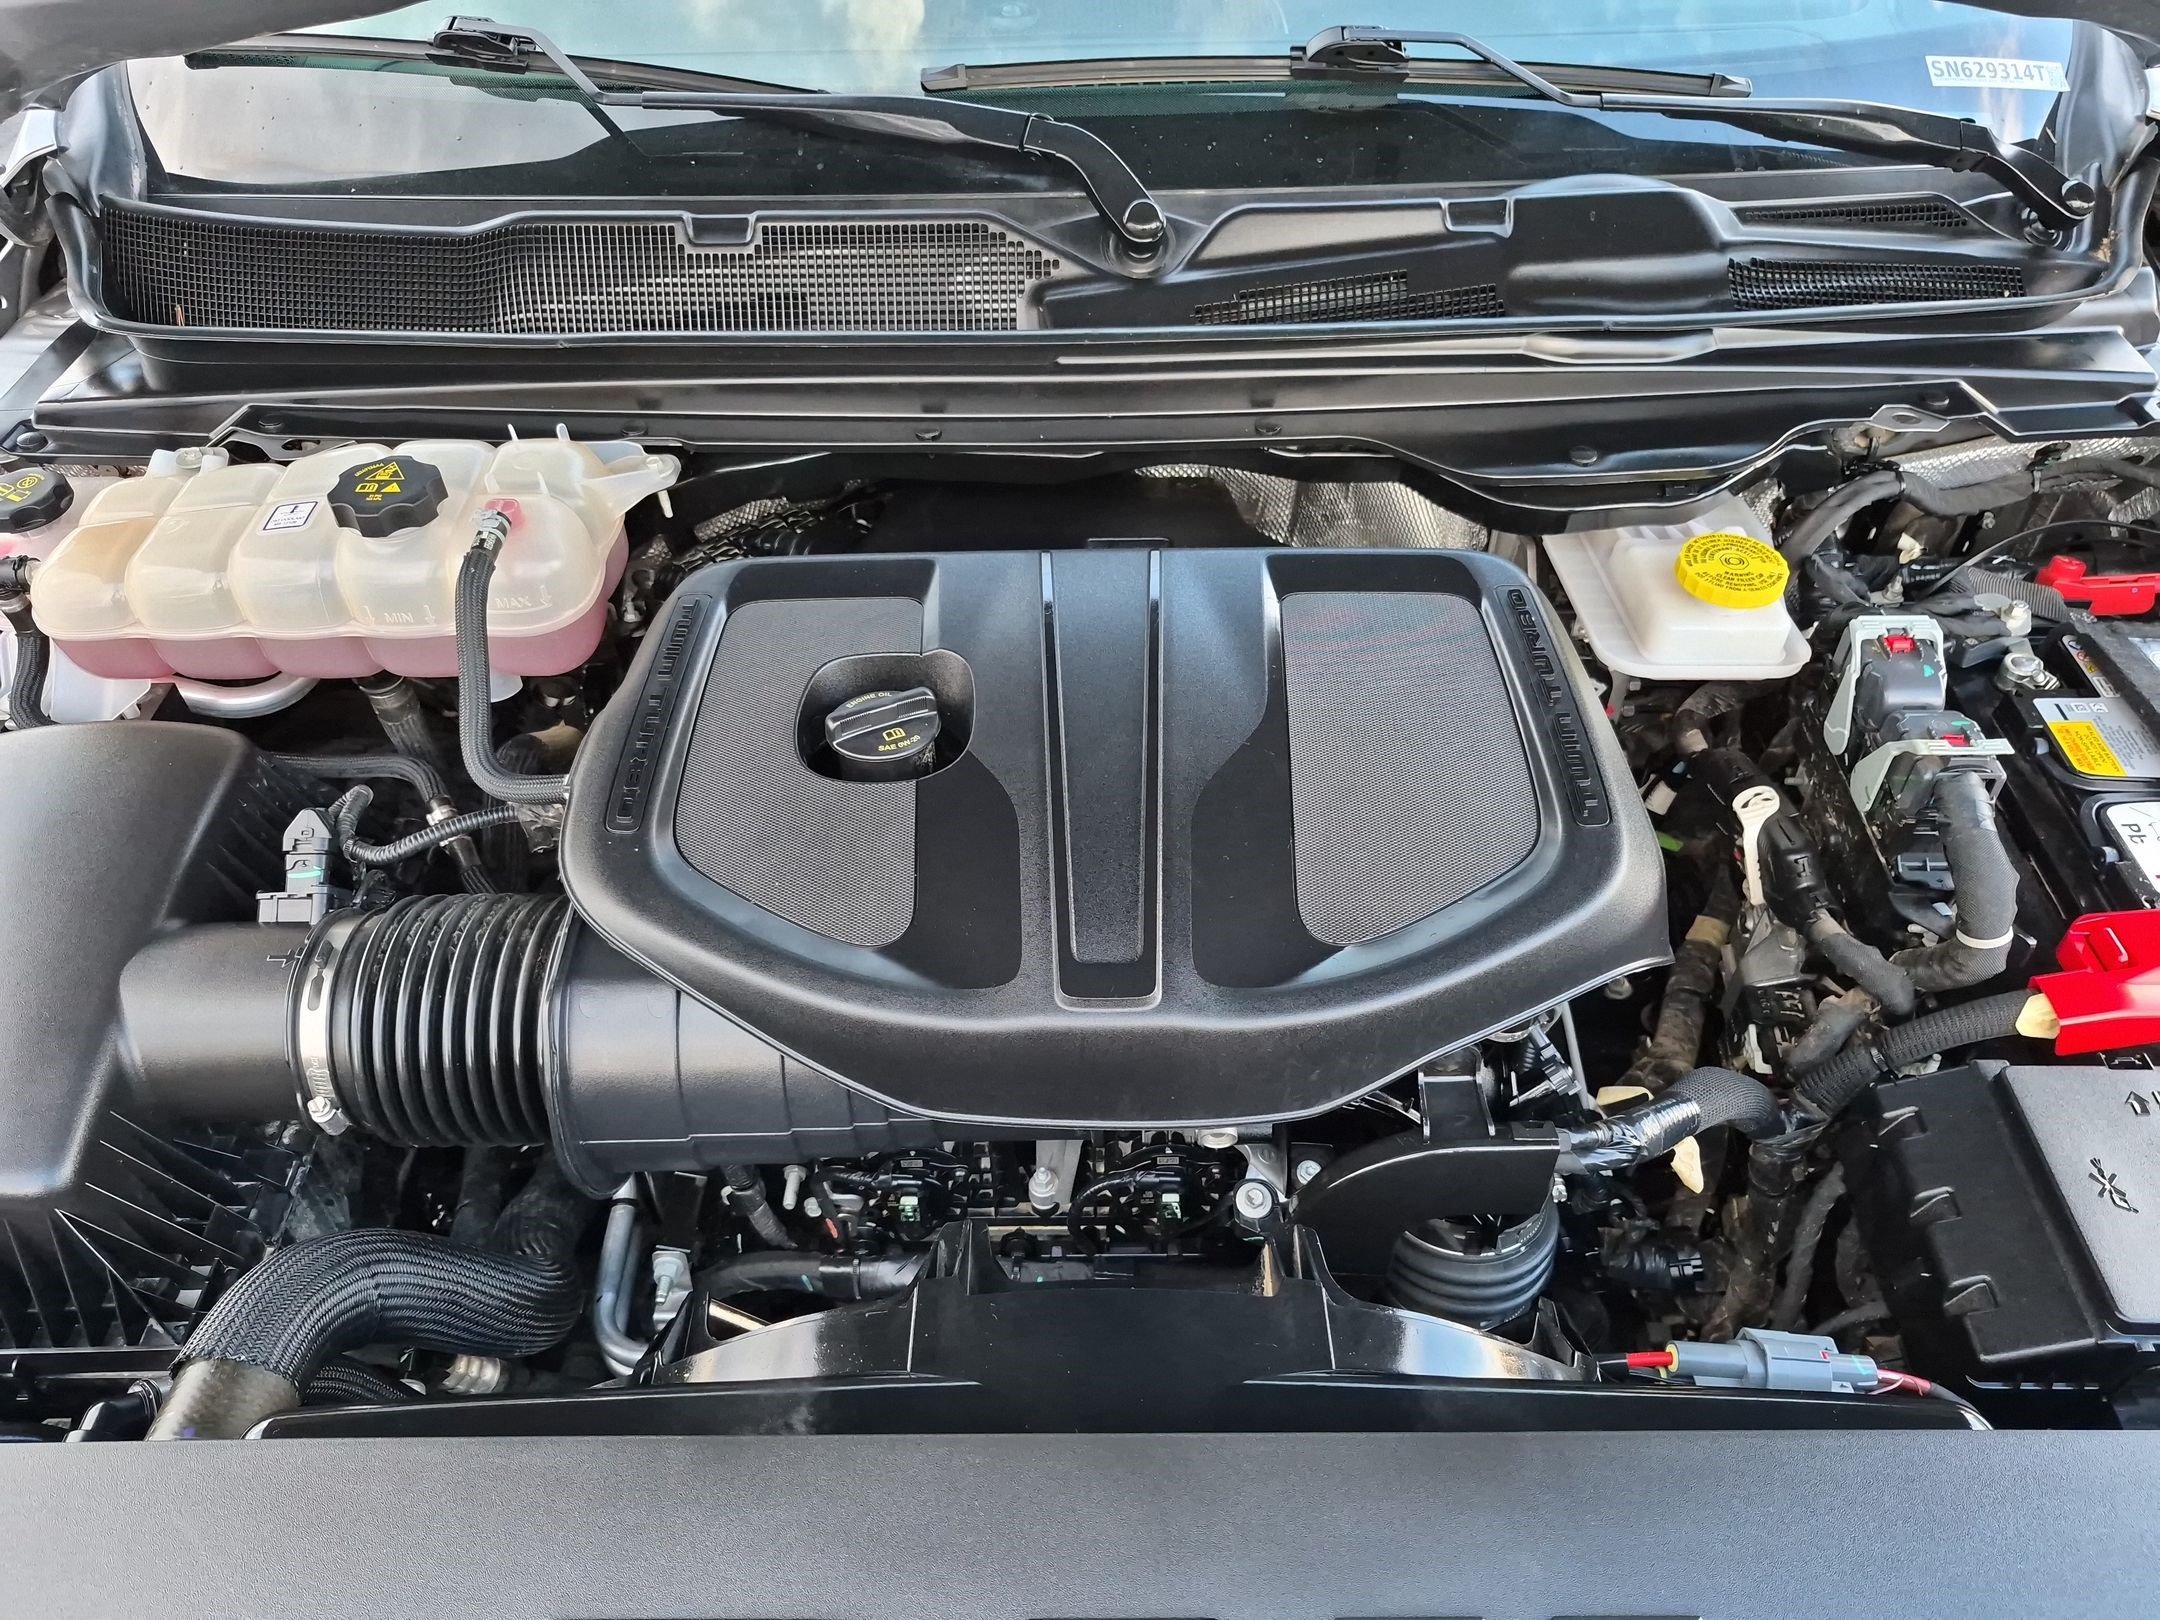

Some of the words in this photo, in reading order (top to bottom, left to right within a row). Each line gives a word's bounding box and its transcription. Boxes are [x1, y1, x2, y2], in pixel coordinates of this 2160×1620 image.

[1932, 60, 2044, 81] SN629314T
[385, 612, 413, 624] MIN
[658, 598, 700, 682] TWIN
[1507, 588, 1562, 707] TURBO
[846, 693, 876, 709] ENGINE
[616, 686, 670, 825] TURBO
[878, 743, 897, 752] SAE
[1555, 712, 1599, 817] TWIN
